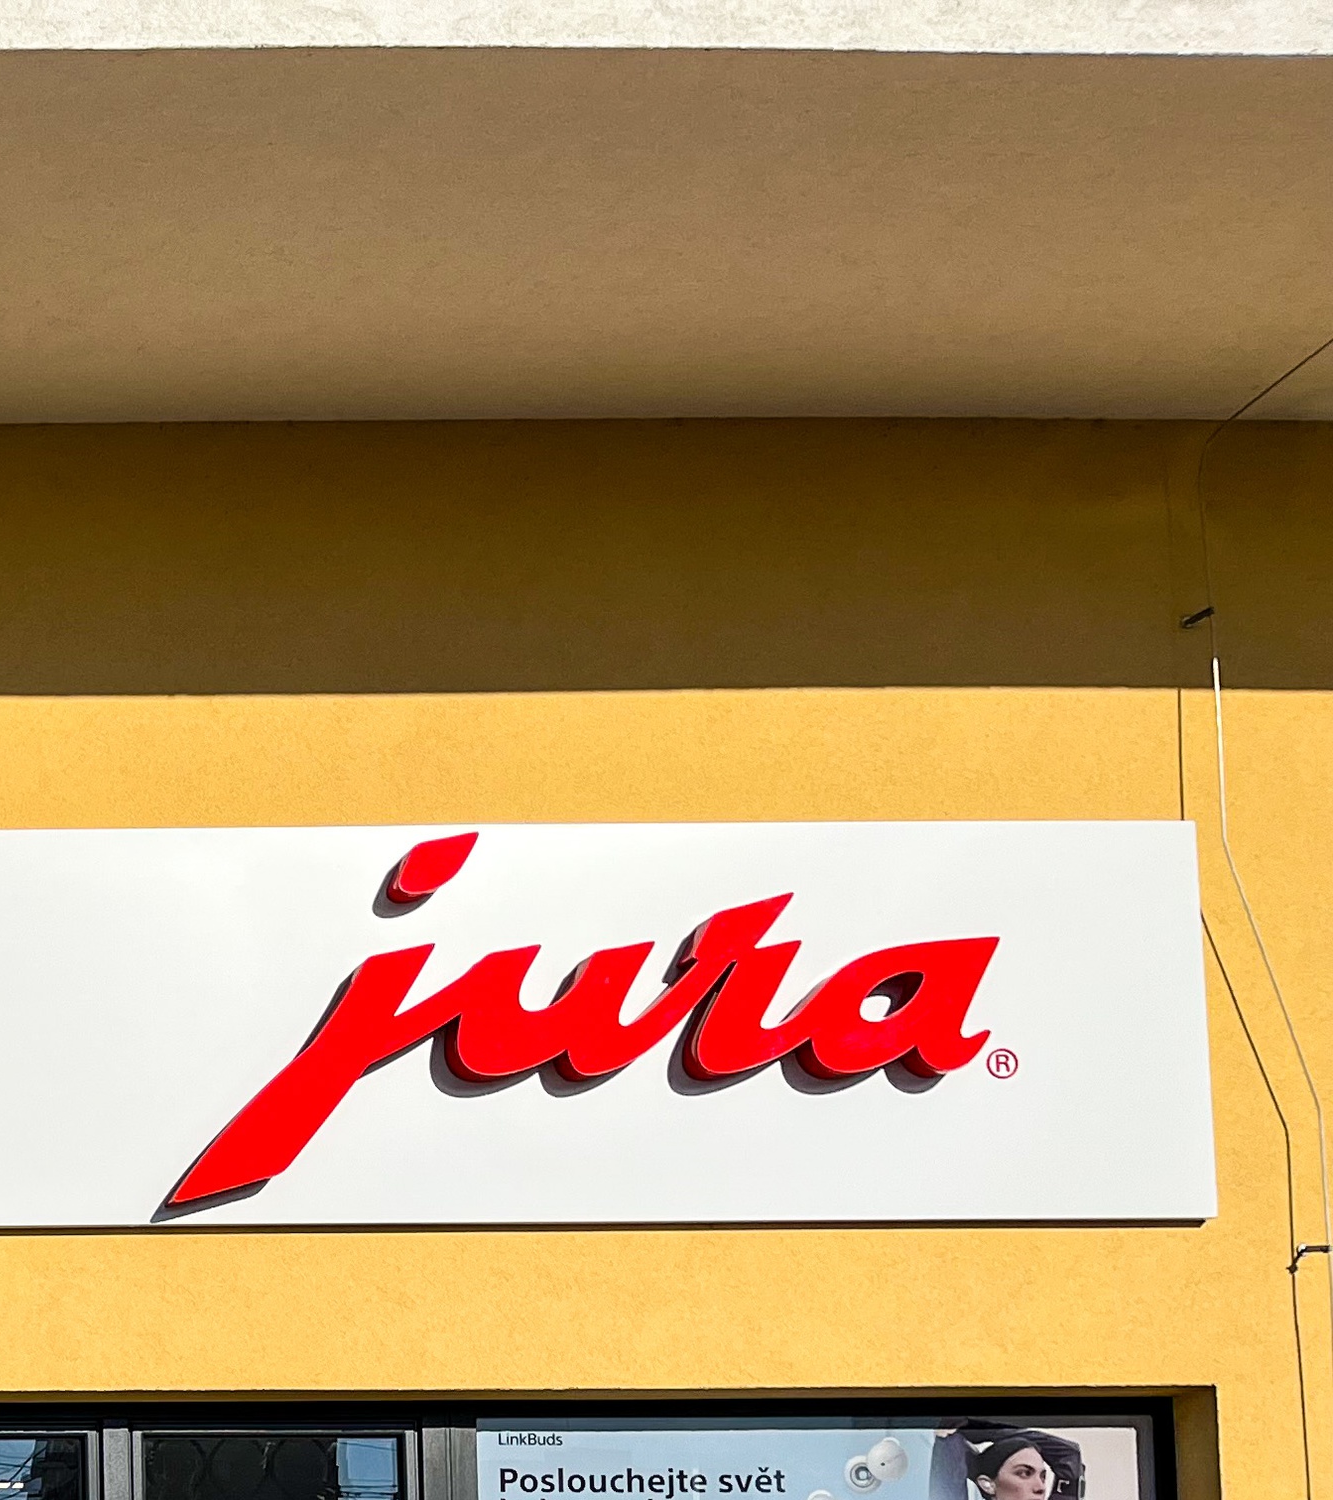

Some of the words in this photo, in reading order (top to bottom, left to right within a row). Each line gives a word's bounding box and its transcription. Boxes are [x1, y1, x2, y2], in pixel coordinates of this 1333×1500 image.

[165, 831, 1001, 1205] jura
[498, 1433, 563, 1446] LinkBuds
[499, 1467, 707, 1499] Poslouchejte
[718, 1467, 786, 1493] svět
